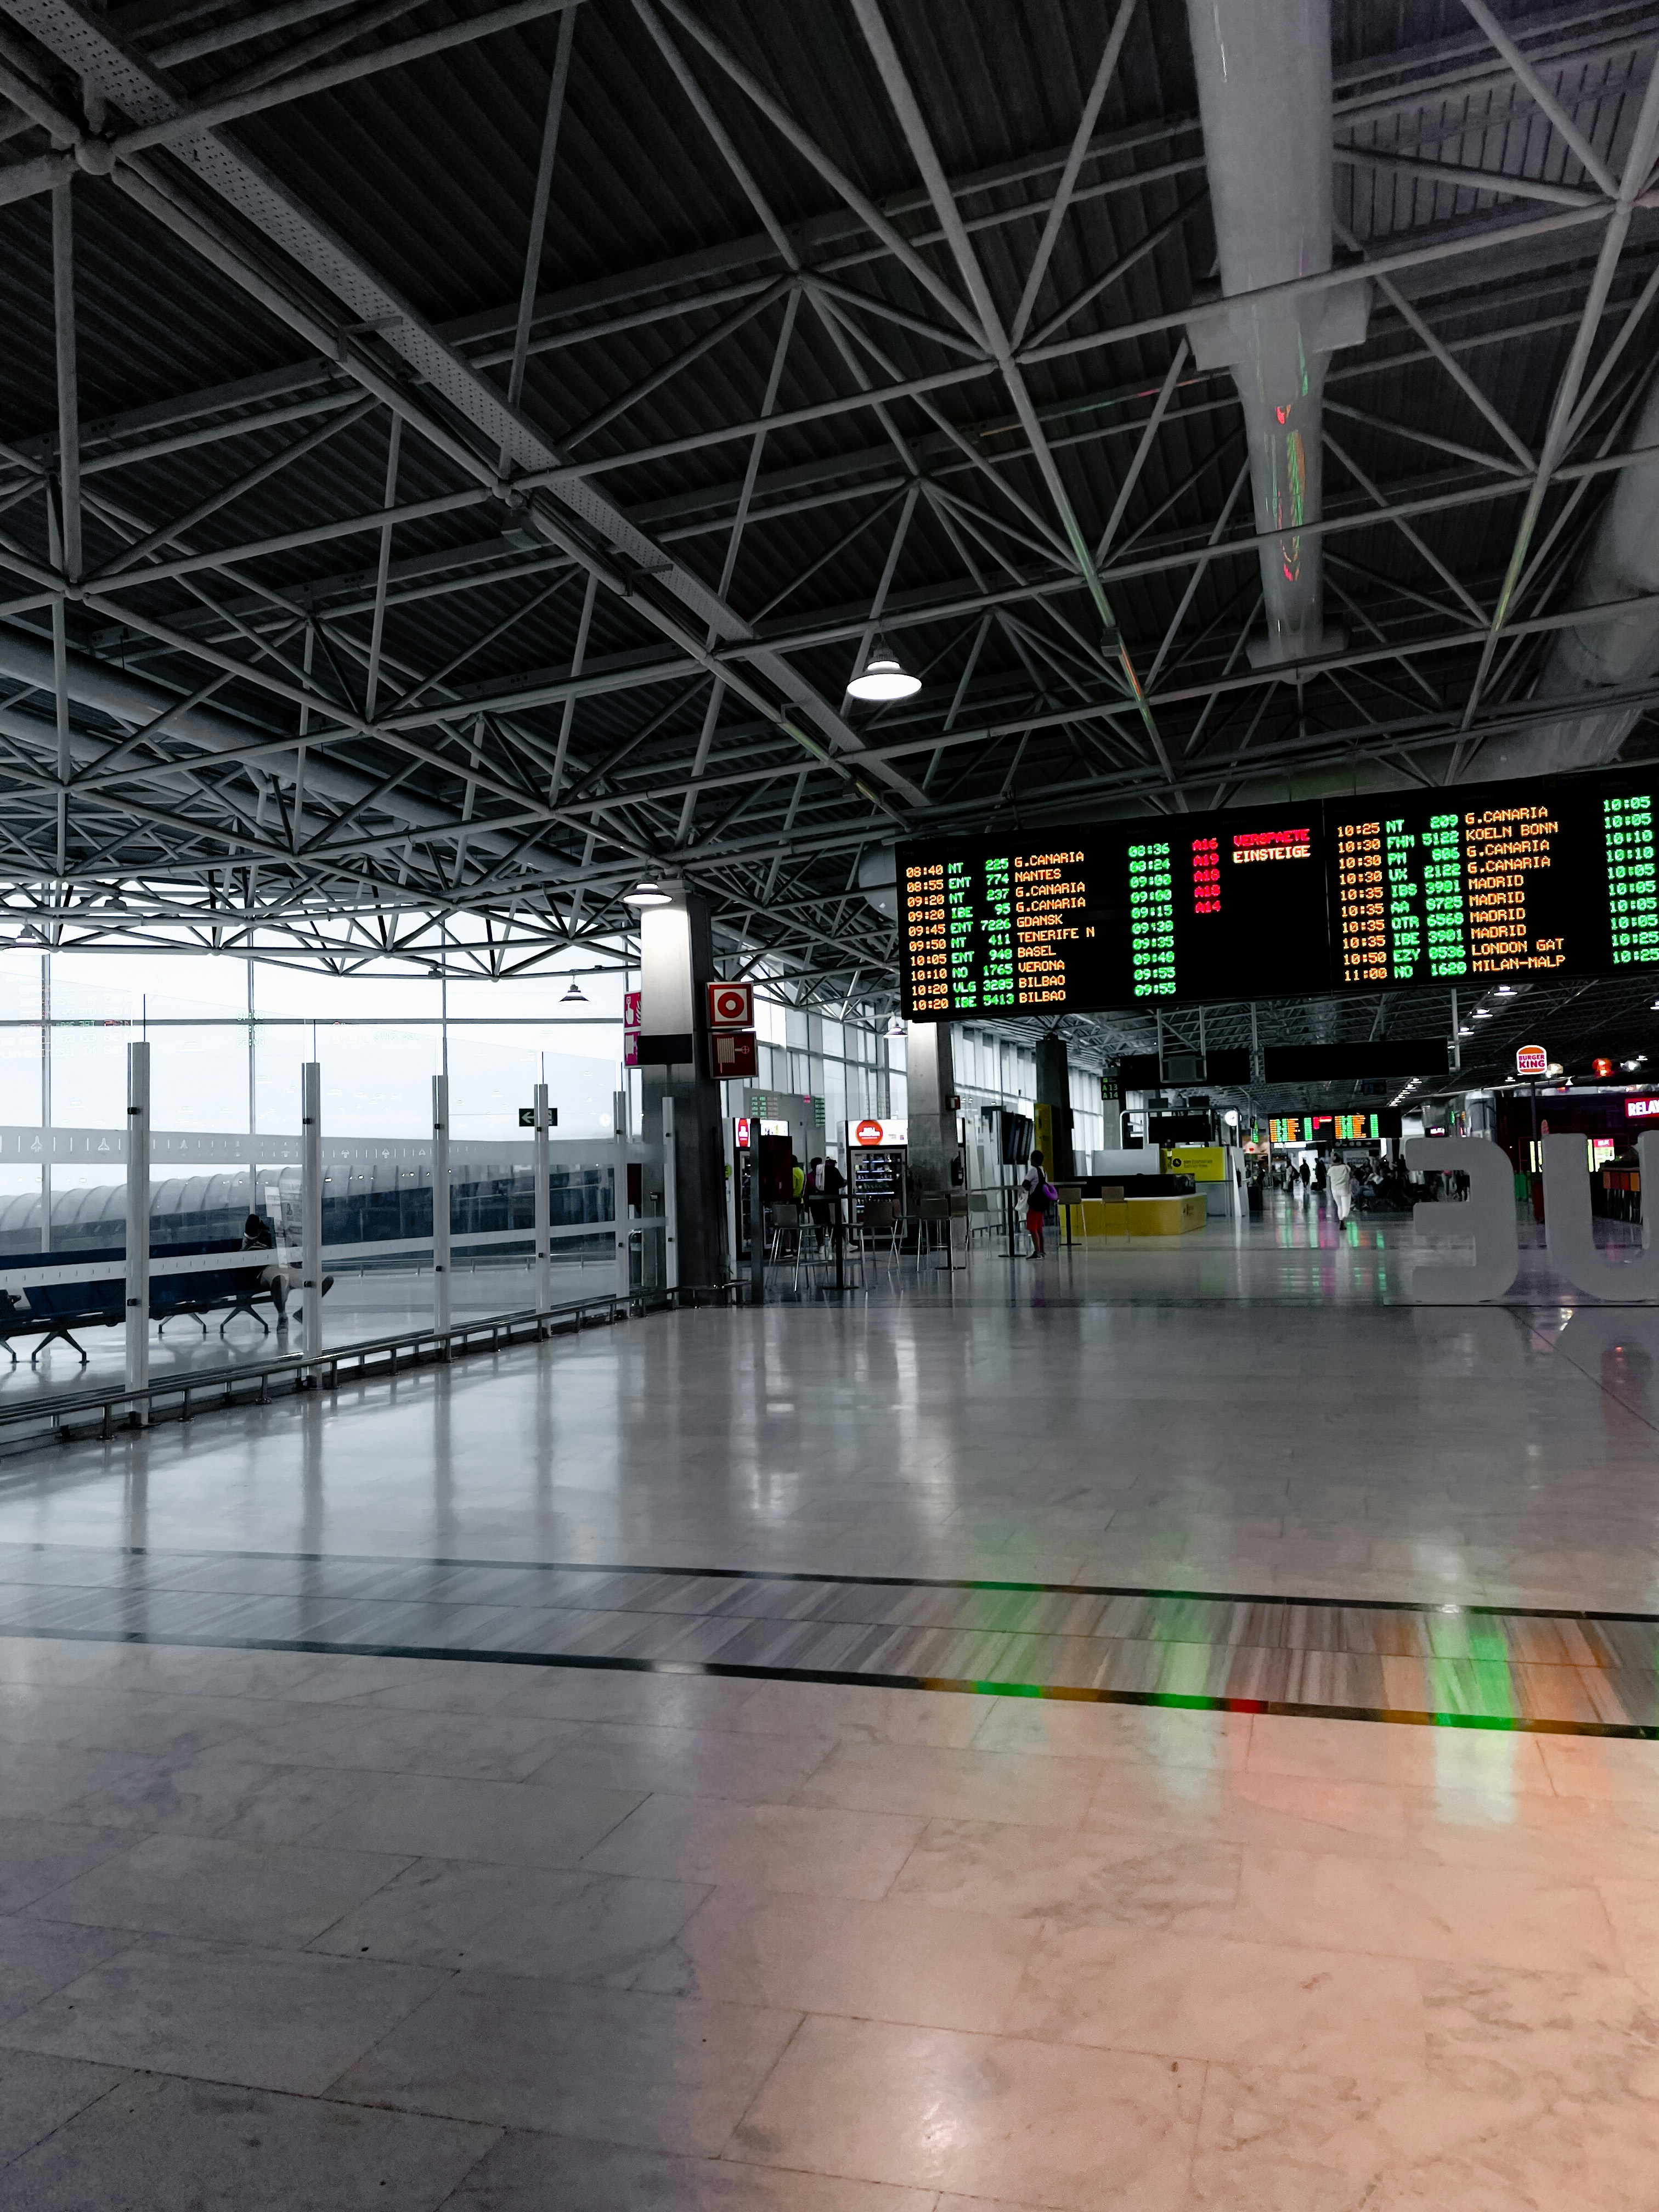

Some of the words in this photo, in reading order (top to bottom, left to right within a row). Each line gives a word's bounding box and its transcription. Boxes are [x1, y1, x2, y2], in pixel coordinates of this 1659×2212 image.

[1338, 822, 1381, 838] 10:25
[1386, 819, 1406, 834] NT
[1465, 806, 1549, 825] G.CANARIA
[1604, 795, 1651, 813] 10:05
[1339, 838, 1382, 854] 10:30
[1387, 834, 1416, 850] FHM
[1422, 830, 1460, 847] 5122
[1466, 826, 1514, 842] KOELN
[1521, 821, 1560, 837] BONN
[1605, 812, 1653, 830] 10:05
[906, 864, 944, 878] 08:40
[948, 862, 964, 874] NT
[985, 857, 1009, 871] 225
[1015, 851, 1085, 868] G.CANARIA
[1128, 842, 1171, 858] 08:36
[1192, 837, 1219, 851] A16
[1233, 828, 1311, 848] VERSPAETE
[907, 879, 945, 893] 08:55
[949, 876, 972, 890] ENT
[986, 873, 1010, 885] 774
[1015, 868, 1062, 883] NANTES
[1129, 857, 1171, 873] 08:24
[1193, 852, 1220, 867] A19
[1233, 844, 1312, 864] EINSTEIGE
[1339, 854, 1383, 870] 10:30
[1387, 851, 1408, 866] PM
[1467, 839, 1550, 859] G.CANARIA
[1606, 830, 1654, 847] 10:10
[1340, 870, 1383, 886] 10:30
[1389, 867, 1408, 882] UX
[1424, 862, 1462, 879] 2122
[1468, 855, 1552, 874] G.CANARIA
[1606, 846, 1655, 863] 10:10
[907, 894, 945, 908] 09:20
[949, 891, 966, 904] NT
[986, 888, 1011, 901] 237
[1016, 881, 1086, 898] G.CANARIA
[1130, 873, 1172, 889] 09:00
[1341, 887, 1384, 901] 10:35
[1391, 883, 1418, 898] IBS
[1469, 874, 1525, 890] MADRID
[1607, 863, 1656, 880] 10:05
[1342, 902, 1385, 918] 10:35
[1391, 900, 1410, 915] AA
[1469, 890, 1526, 908] MADRID
[1609, 880, 1657, 897] 10:05
[909, 909, 946, 922] 09:20
[952, 906, 974, 919] IBE
[995, 902, 1012, 915] 95
[1016, 896, 1086, 912] G.CANARIA
[1130, 889, 1172, 904] 09:00
[909, 923, 946, 937] 09:45
[950, 921, 974, 934] ENT
[980, 918, 1012, 932] 7226
[1017, 913, 1064, 928] GDANSK
[1131, 904, 1174, 919] 09:15
[1195, 900, 1222, 913] A14
[1342, 919, 1386, 934] 10:35
[1392, 915, 1420, 930] QTR
[1427, 911, 1465, 928] 6568
[1469, 907, 1527, 924] MADRID
[1610, 897, 1658, 913] 10:05
[910, 938, 947, 952] 09:50
[951, 936, 967, 949] NT
[989, 933, 1011, 946] 411
[1017, 928, 1080, 943] TENERIFE
[1086, 926, 1096, 938] N
[1132, 920, 1175, 935] 09:30
[1343, 934, 1386, 950] 10:35
[1394, 931, 1421, 946] IBE
[1471, 924, 1527, 939] MADRID
[1610, 913, 1659, 930] 10:05
[1344, 951, 1387, 966] 10:50
[1393, 948, 1421, 963] EZY
[1471, 940, 1528, 956] LONDON
[1536, 938, 1565, 952] GAT
[1612, 930, 1659, 947] 10:25
[911, 953, 947, 967] 10:05
[951, 951, 975, 964] ENT
[1018, 945, 1057, 958] BASEL
[1132, 935, 1175, 950] 09:35
[912, 968, 948, 981] 10:10
[952, 966, 969, 978] NO
[984, 963, 1014, 977] 1765
[1018, 959, 1066, 973] VERONA
[1133, 951, 1176, 966] 09:40
[1345, 967, 1389, 981] 11:00
[1394, 964, 1414, 979] NO
[1431, 961, 1468, 977] 1620
[1472, 955, 1566, 973] MILAN-MALP
[1612, 947, 1659, 964] 10:25
[912, 983, 949, 996] 10:20
[953, 981, 977, 993] VLG
[1019, 974, 1066, 989] BILBAO
[1134, 966, 1177, 981] 09:55
[913, 998, 950, 1011] 10:20
[955, 996, 978, 1008] IBE
[983, 993, 1015, 1006] 5413
[1019, 990, 1066, 1003] BILBAO
[1135, 981, 1177, 997] 09:55
[1628, 1099, 1659, 1116] RELAY
